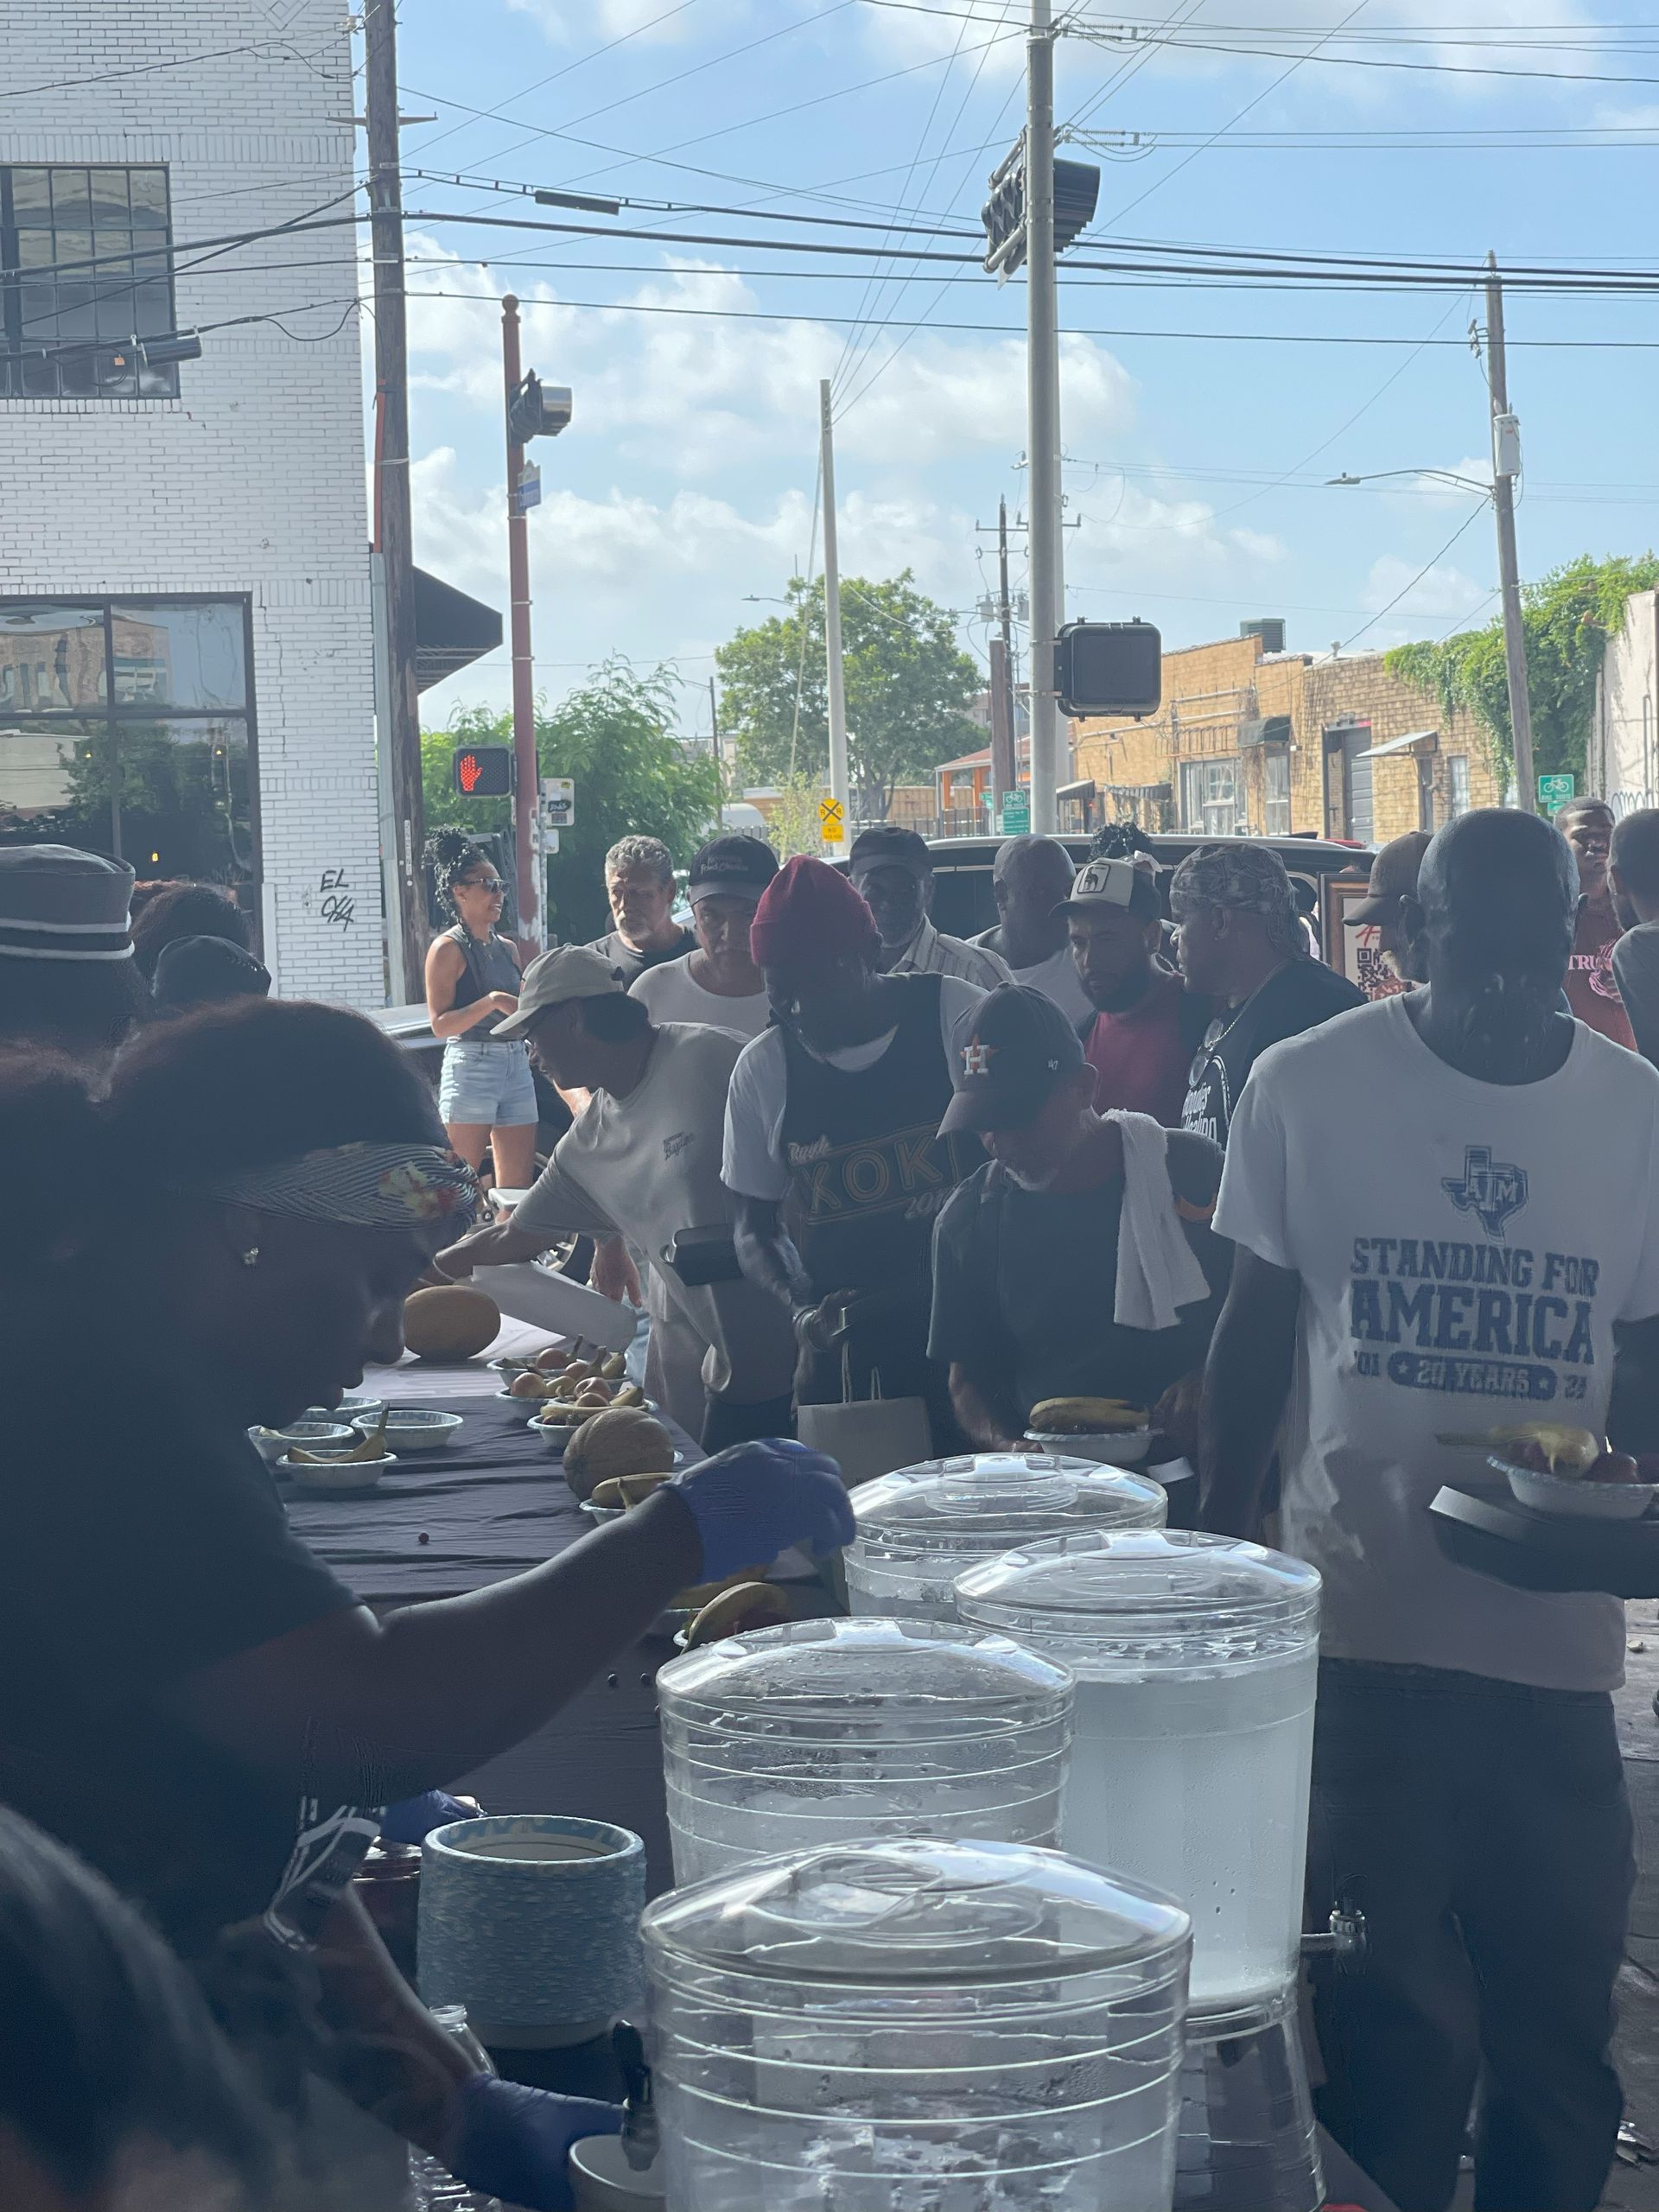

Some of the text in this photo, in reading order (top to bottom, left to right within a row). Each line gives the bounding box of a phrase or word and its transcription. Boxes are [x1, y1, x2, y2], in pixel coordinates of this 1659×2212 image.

[320, 868, 349, 893] EL
[963, 1044, 990, 1076] H
[1350, 1236, 1600, 1297] STANDING FOR
[1351, 1278, 1597, 1366] AMERICA
[1414, 1359, 1448, 1386] 20
